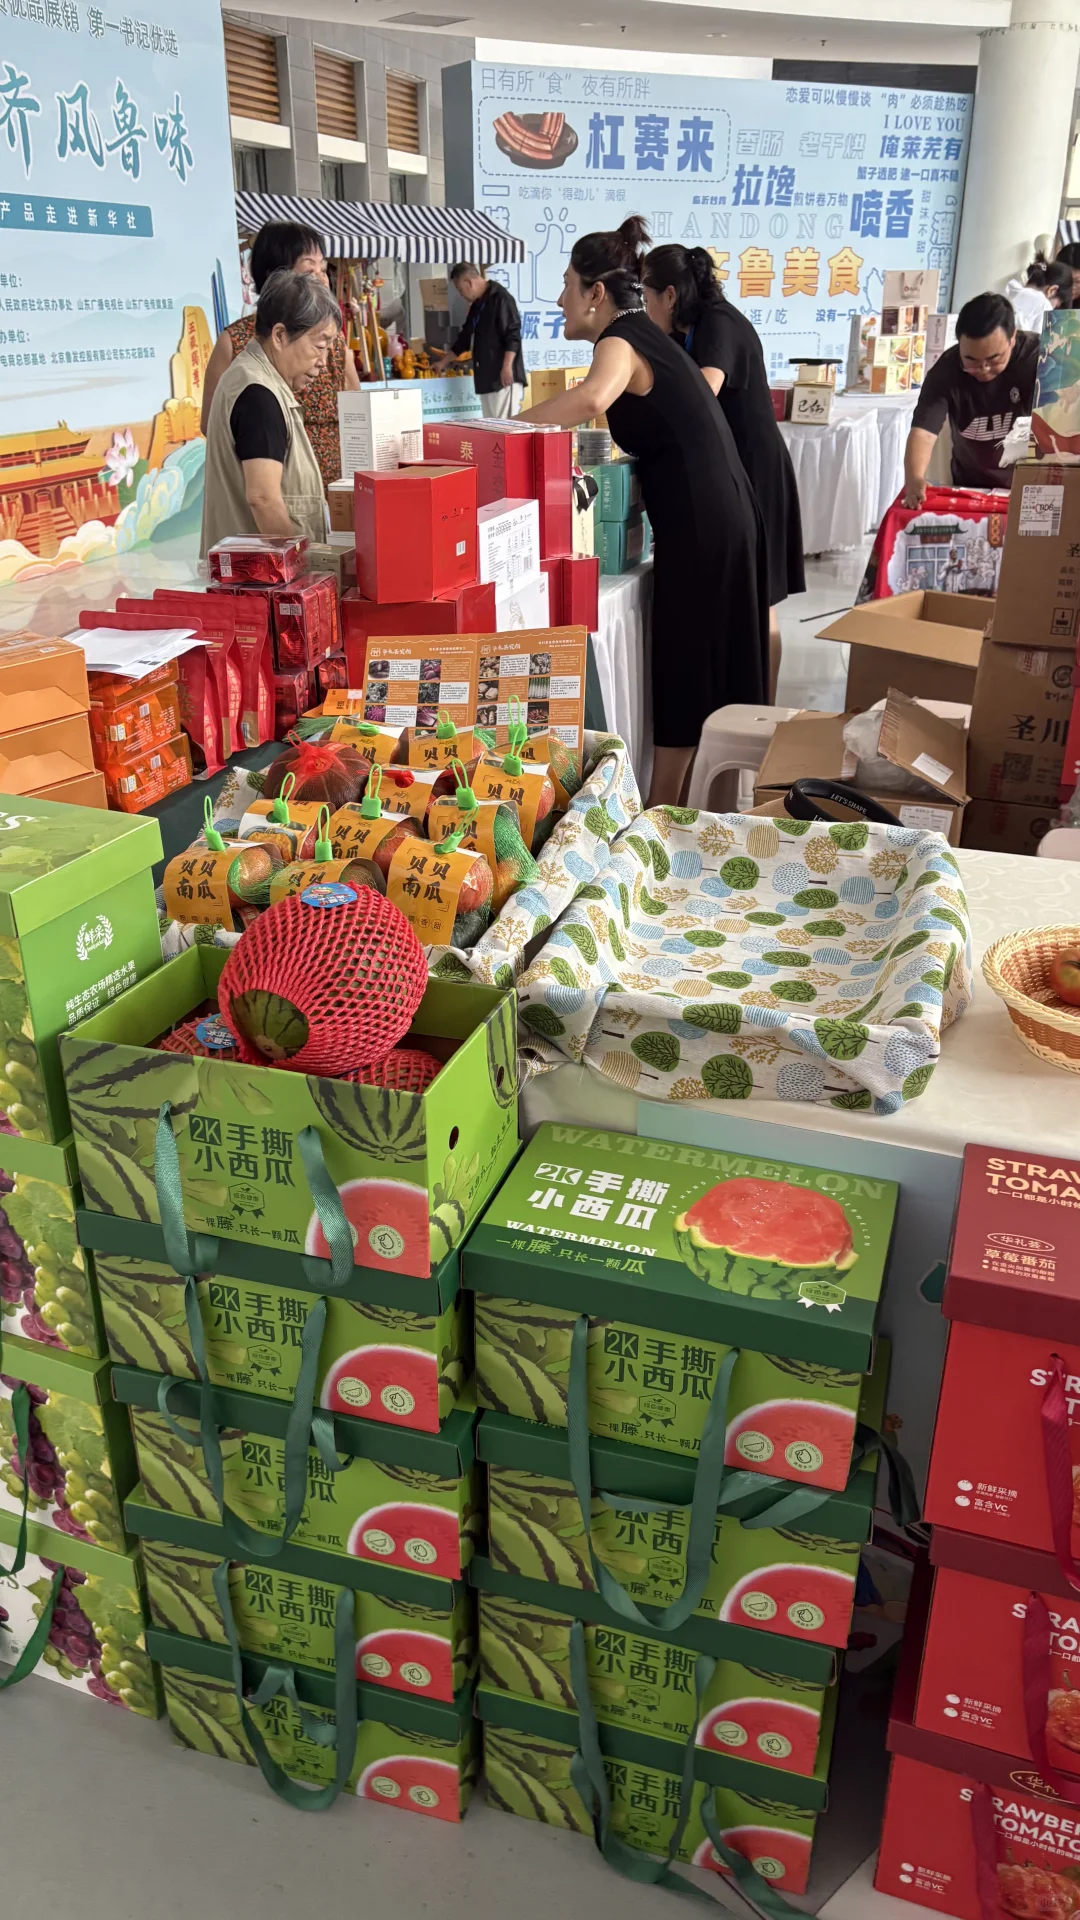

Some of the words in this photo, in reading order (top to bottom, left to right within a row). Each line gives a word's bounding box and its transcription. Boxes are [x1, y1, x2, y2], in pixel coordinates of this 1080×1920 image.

[0, 0, 80, 33] 优品展销
[87, 7, 179, 57] 第一书记优选
[884, 115, 889, 129] I
[895, 115, 931, 131] LOVE
[937, 117, 965, 132] YOU
[586, 112, 715, 172] 杠赛来
[736, 129, 784, 157] 香肠
[880, 135, 964, 161] 俺莱芜有
[850, 189, 914, 238] 喷香
[461, 441, 474, 460] 泰
[1006, 713, 1070, 747] 圣川
[424, 744, 458, 761] 贝贝
[487, 783, 525, 806] 贝贝
[333, 825, 371, 843] 贝贝
[179, 858, 217, 877] 贝贝
[407, 855, 451, 881] 贝贝
[176, 878, 216, 901] 南瓜
[402, 875, 443, 904] 南瓜
[66, 960, 136, 1012] 纯生态农场精选水果
[194, 1145, 296, 1188] 小西瓜
[549, 1125, 888, 1200] WATERMELON
[526, 1186, 660, 1232] 小西瓜
[506, 1219, 658, 1258] WATERMELON
[985, 1248, 1057, 1270] 草莓番茄
[605, 1357, 713, 1402] 小西瓜
[242, 1440, 335, 1484] 2K撕
[974, 1498, 1008, 1512] 富含VC
[249, 1593, 336, 1629] 小西瓜
[596, 1655, 693, 1694] 小西瓜
[959, 1788, 1080, 1837] SRAWBE
